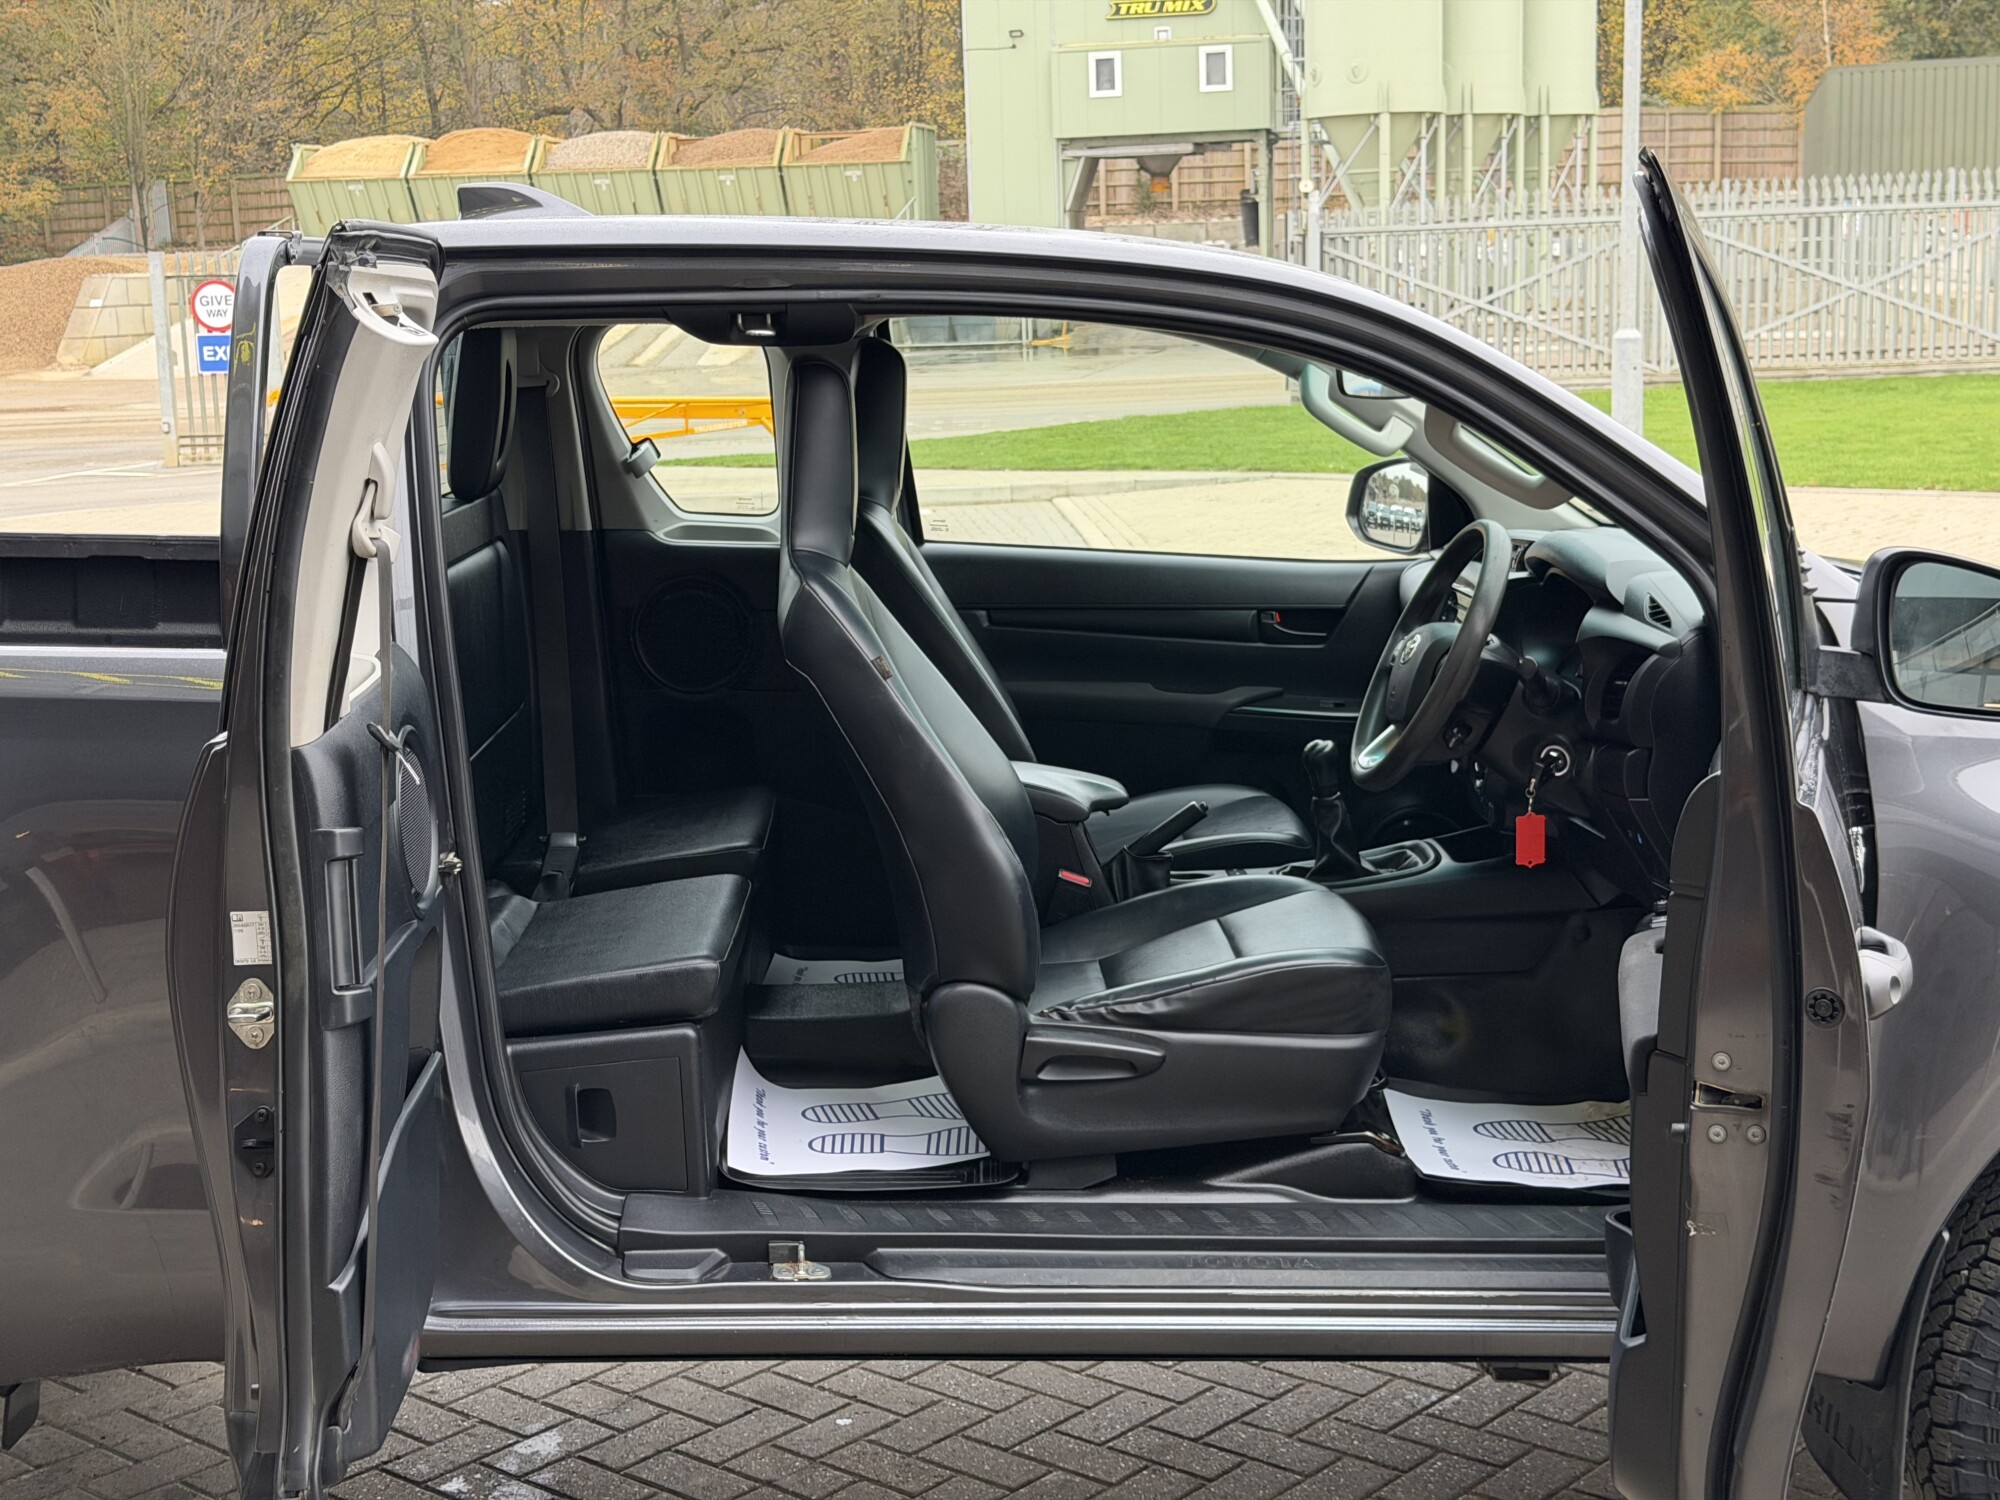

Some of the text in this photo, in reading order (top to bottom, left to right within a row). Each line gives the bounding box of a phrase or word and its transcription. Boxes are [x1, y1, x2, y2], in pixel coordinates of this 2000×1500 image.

[1118, 0, 1206, 14] TRU MIX
[199, 294, 233, 306] GIVE
[206, 308, 229, 319] WAY
[752, 1104, 765, 1119] you
[754, 1126, 768, 1141] your
[1178, 1255, 1321, 1269] TOYOTA
